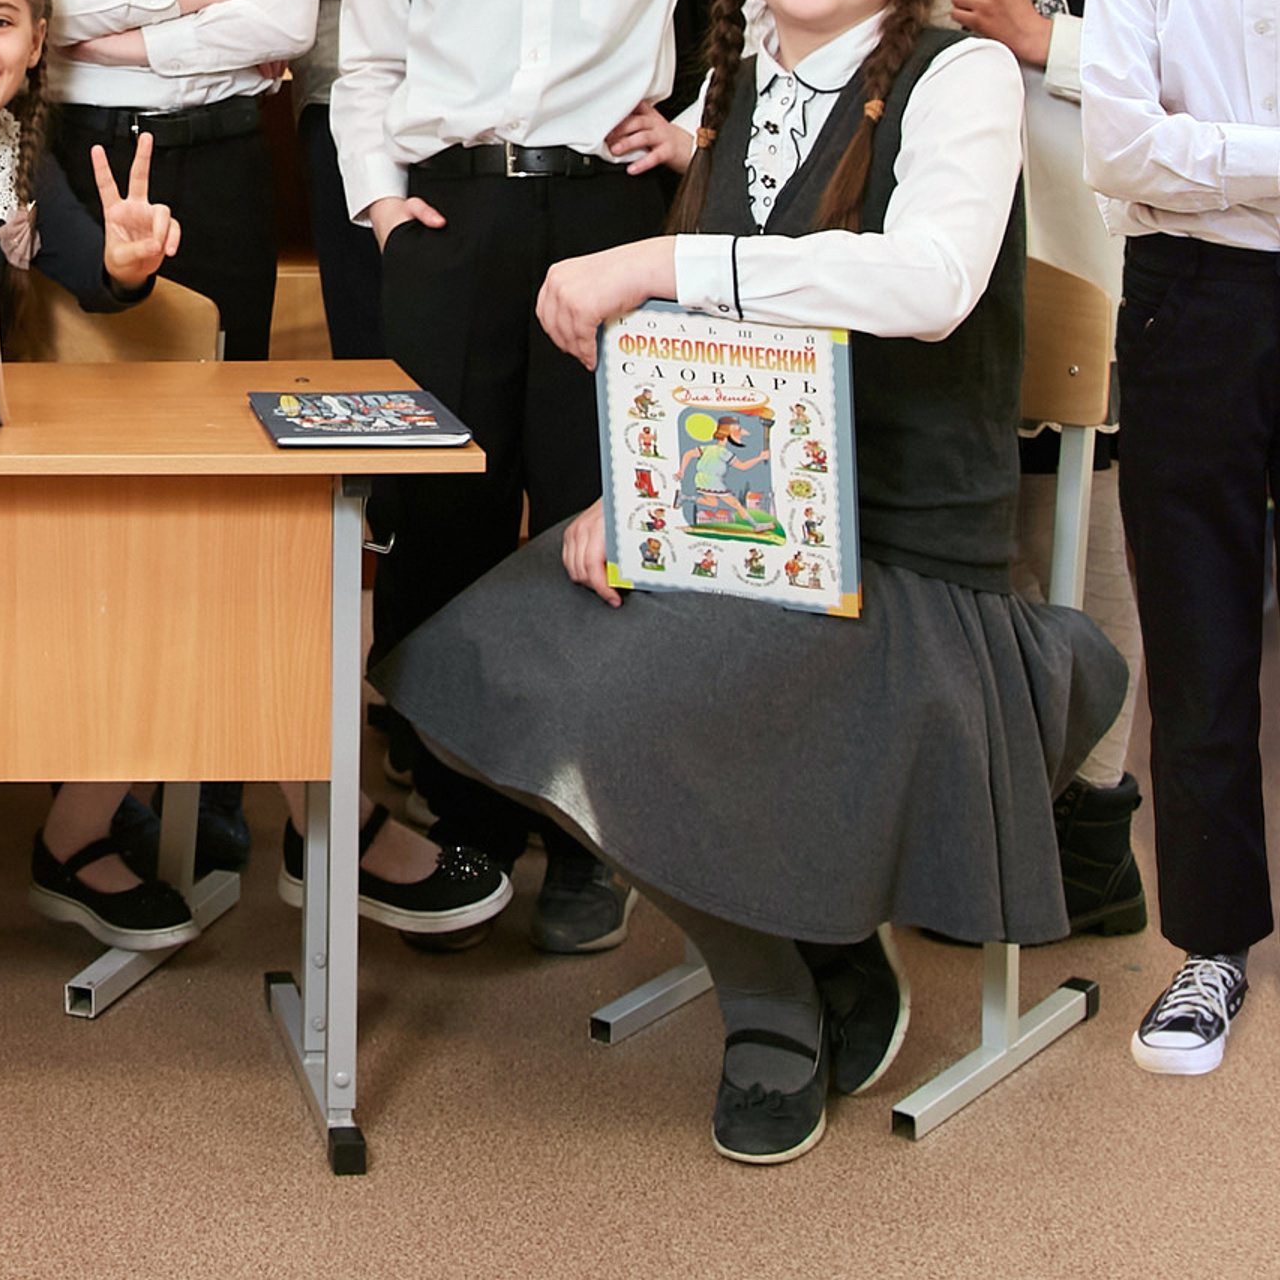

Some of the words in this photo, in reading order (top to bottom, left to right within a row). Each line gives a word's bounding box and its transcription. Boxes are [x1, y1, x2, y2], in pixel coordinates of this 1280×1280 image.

[618, 332, 817, 375] ФРАЗЕОЛОГИЧЕСКИЙ
[621, 361, 818, 394] СЛОВАРЬ
[681, 388, 711, 403] Для
[715, 387, 757, 402] детей
